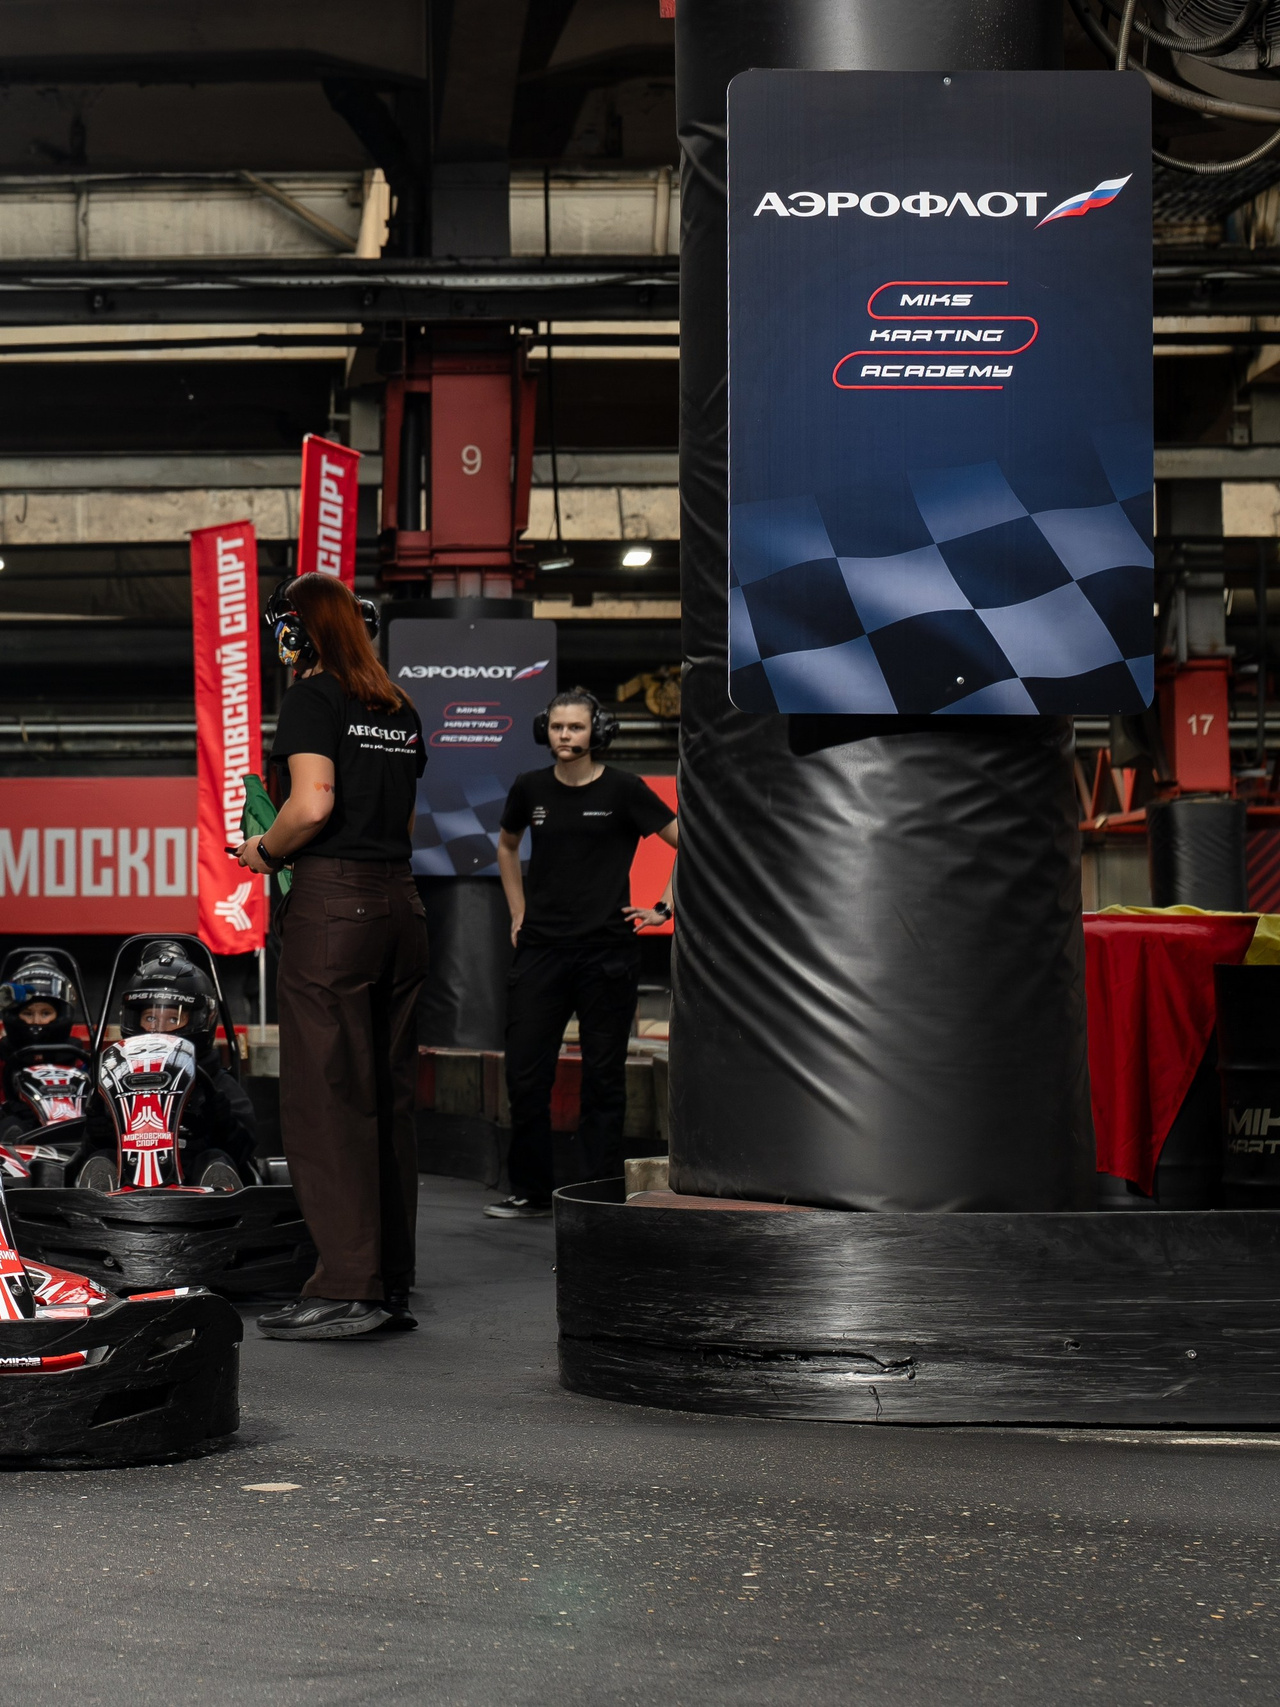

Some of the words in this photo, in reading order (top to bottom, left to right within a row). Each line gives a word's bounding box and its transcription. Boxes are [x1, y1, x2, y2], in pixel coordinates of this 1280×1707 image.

[753, 191, 1048, 218] АЭРОФЛОТ
[899, 293, 974, 307] MIKS
[869, 329, 1005, 343] KARTING
[860, 364, 1014, 378] ACADEMY
[461, 445, 482, 475] 9
[317, 455, 345, 577] СПОРТ
[217, 536, 247, 634] СПОРТ
[398, 665, 516, 679] АЭРОФЛОТ
[455, 706, 487, 714] MIKS
[443, 720, 499, 729] KARTING
[1187, 713, 1215, 736] 17
[38, 1070, 68, 1078] 25
[124, 1132, 172, 1142] МОСКОВСКИЙ
[135, 1139, 159, 1148] СПОРТ
